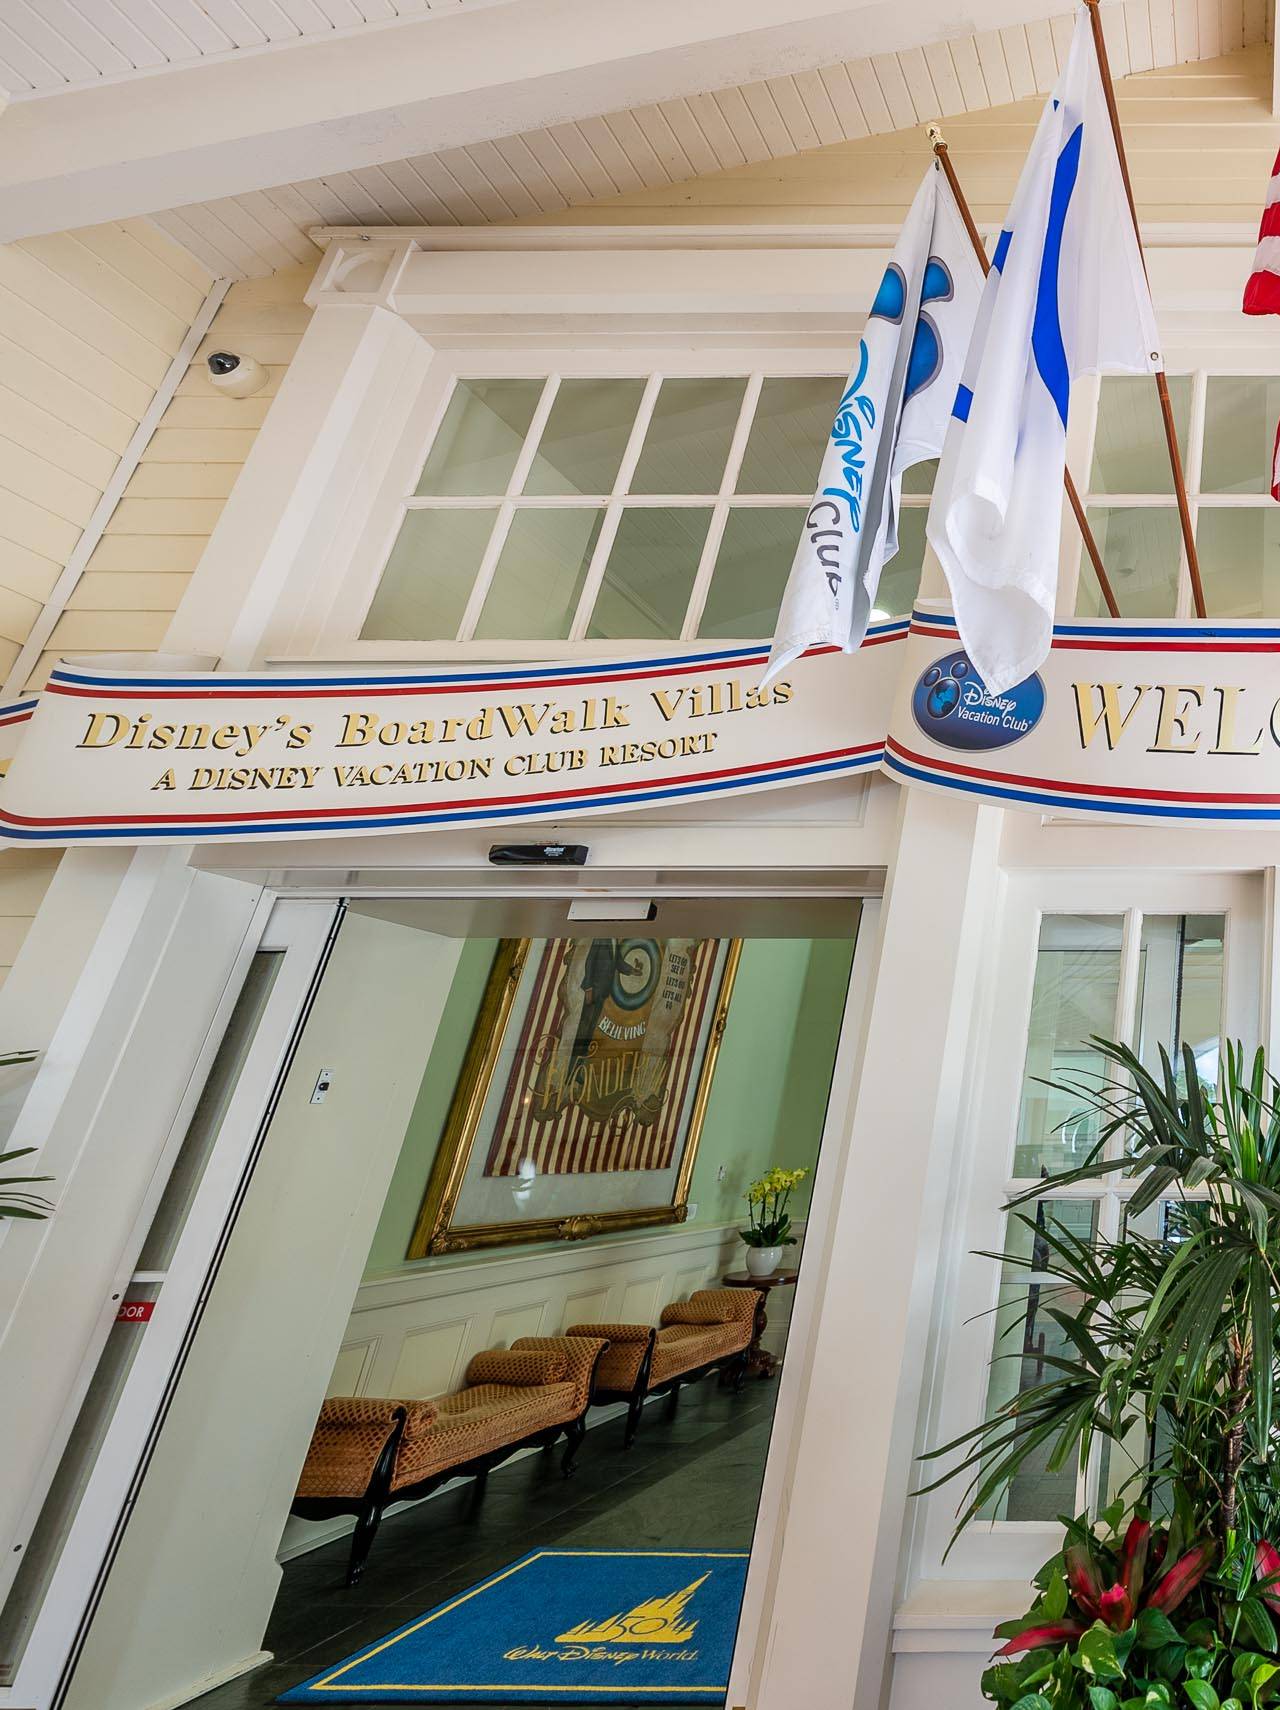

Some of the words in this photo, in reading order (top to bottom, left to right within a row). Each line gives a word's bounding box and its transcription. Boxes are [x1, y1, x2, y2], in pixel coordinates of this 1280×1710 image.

[75, 712, 315, 757] Disney's
[335, 696, 630, 747] BoardWalk
[649, 679, 794, 722] Villas
[958, 706, 1000, 726] Vacation
[1002, 715, 1029, 732] Club
[150, 767, 177, 791] A
[188, 766, 322, 791] DISNEY
[333, 757, 496, 787] VACATION
[504, 745, 590, 776] CLUB
[598, 731, 718, 768] RESORT
[598, 1015, 646, 1041] BELIEVING
[118, 1306, 144, 1317] OOR
[558, 1645, 639, 1666] Disney
[641, 1649, 697, 1661] World
